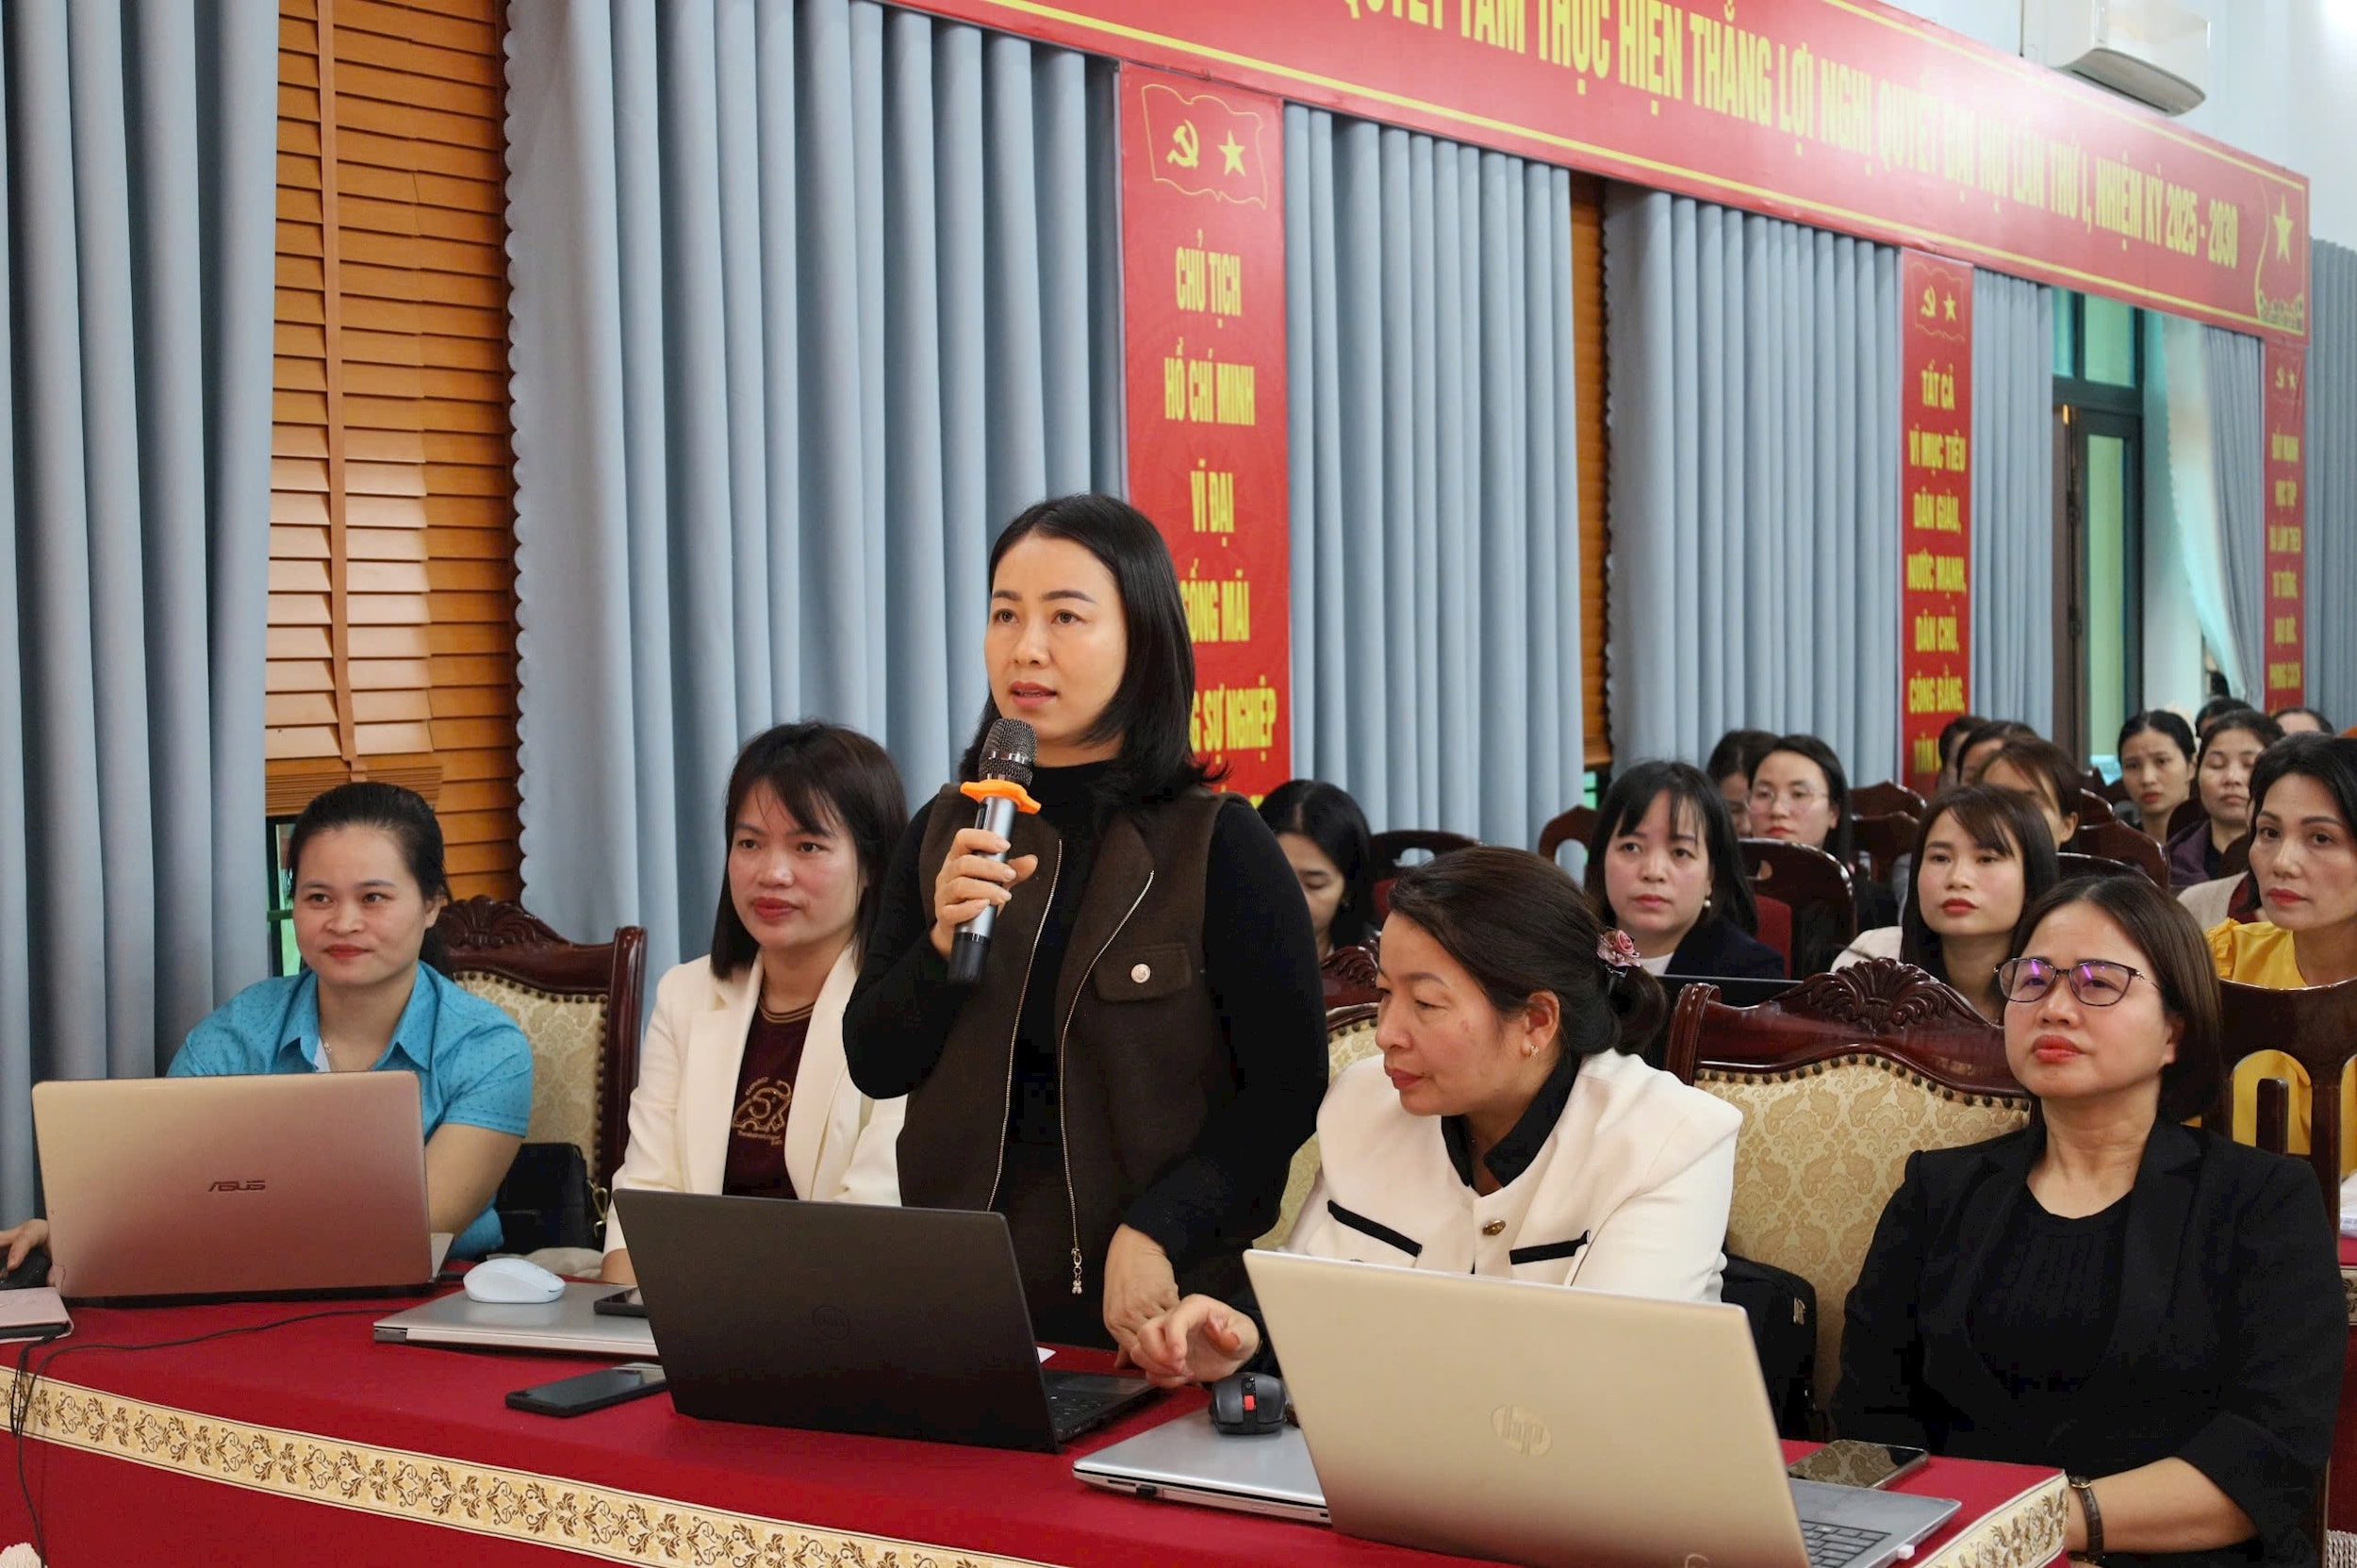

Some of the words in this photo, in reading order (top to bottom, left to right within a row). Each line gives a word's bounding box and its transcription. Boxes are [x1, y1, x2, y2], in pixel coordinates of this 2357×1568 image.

[1779, 41, 1813, 157] LỢI
[2145, 161, 2164, 247] KỲ
[2166, 179, 2199, 256] 2025
[2207, 197, 2238, 270] 2030
[1176, 228, 1206, 312] CHỦ
[1208, 251, 1242, 329] TỊCH
[1164, 336, 1185, 421] HỒ
[1189, 347, 1213, 422] CHÍ
[1216, 362, 1256, 426] MINH
[208, 1180, 266, 1192] ASUS
